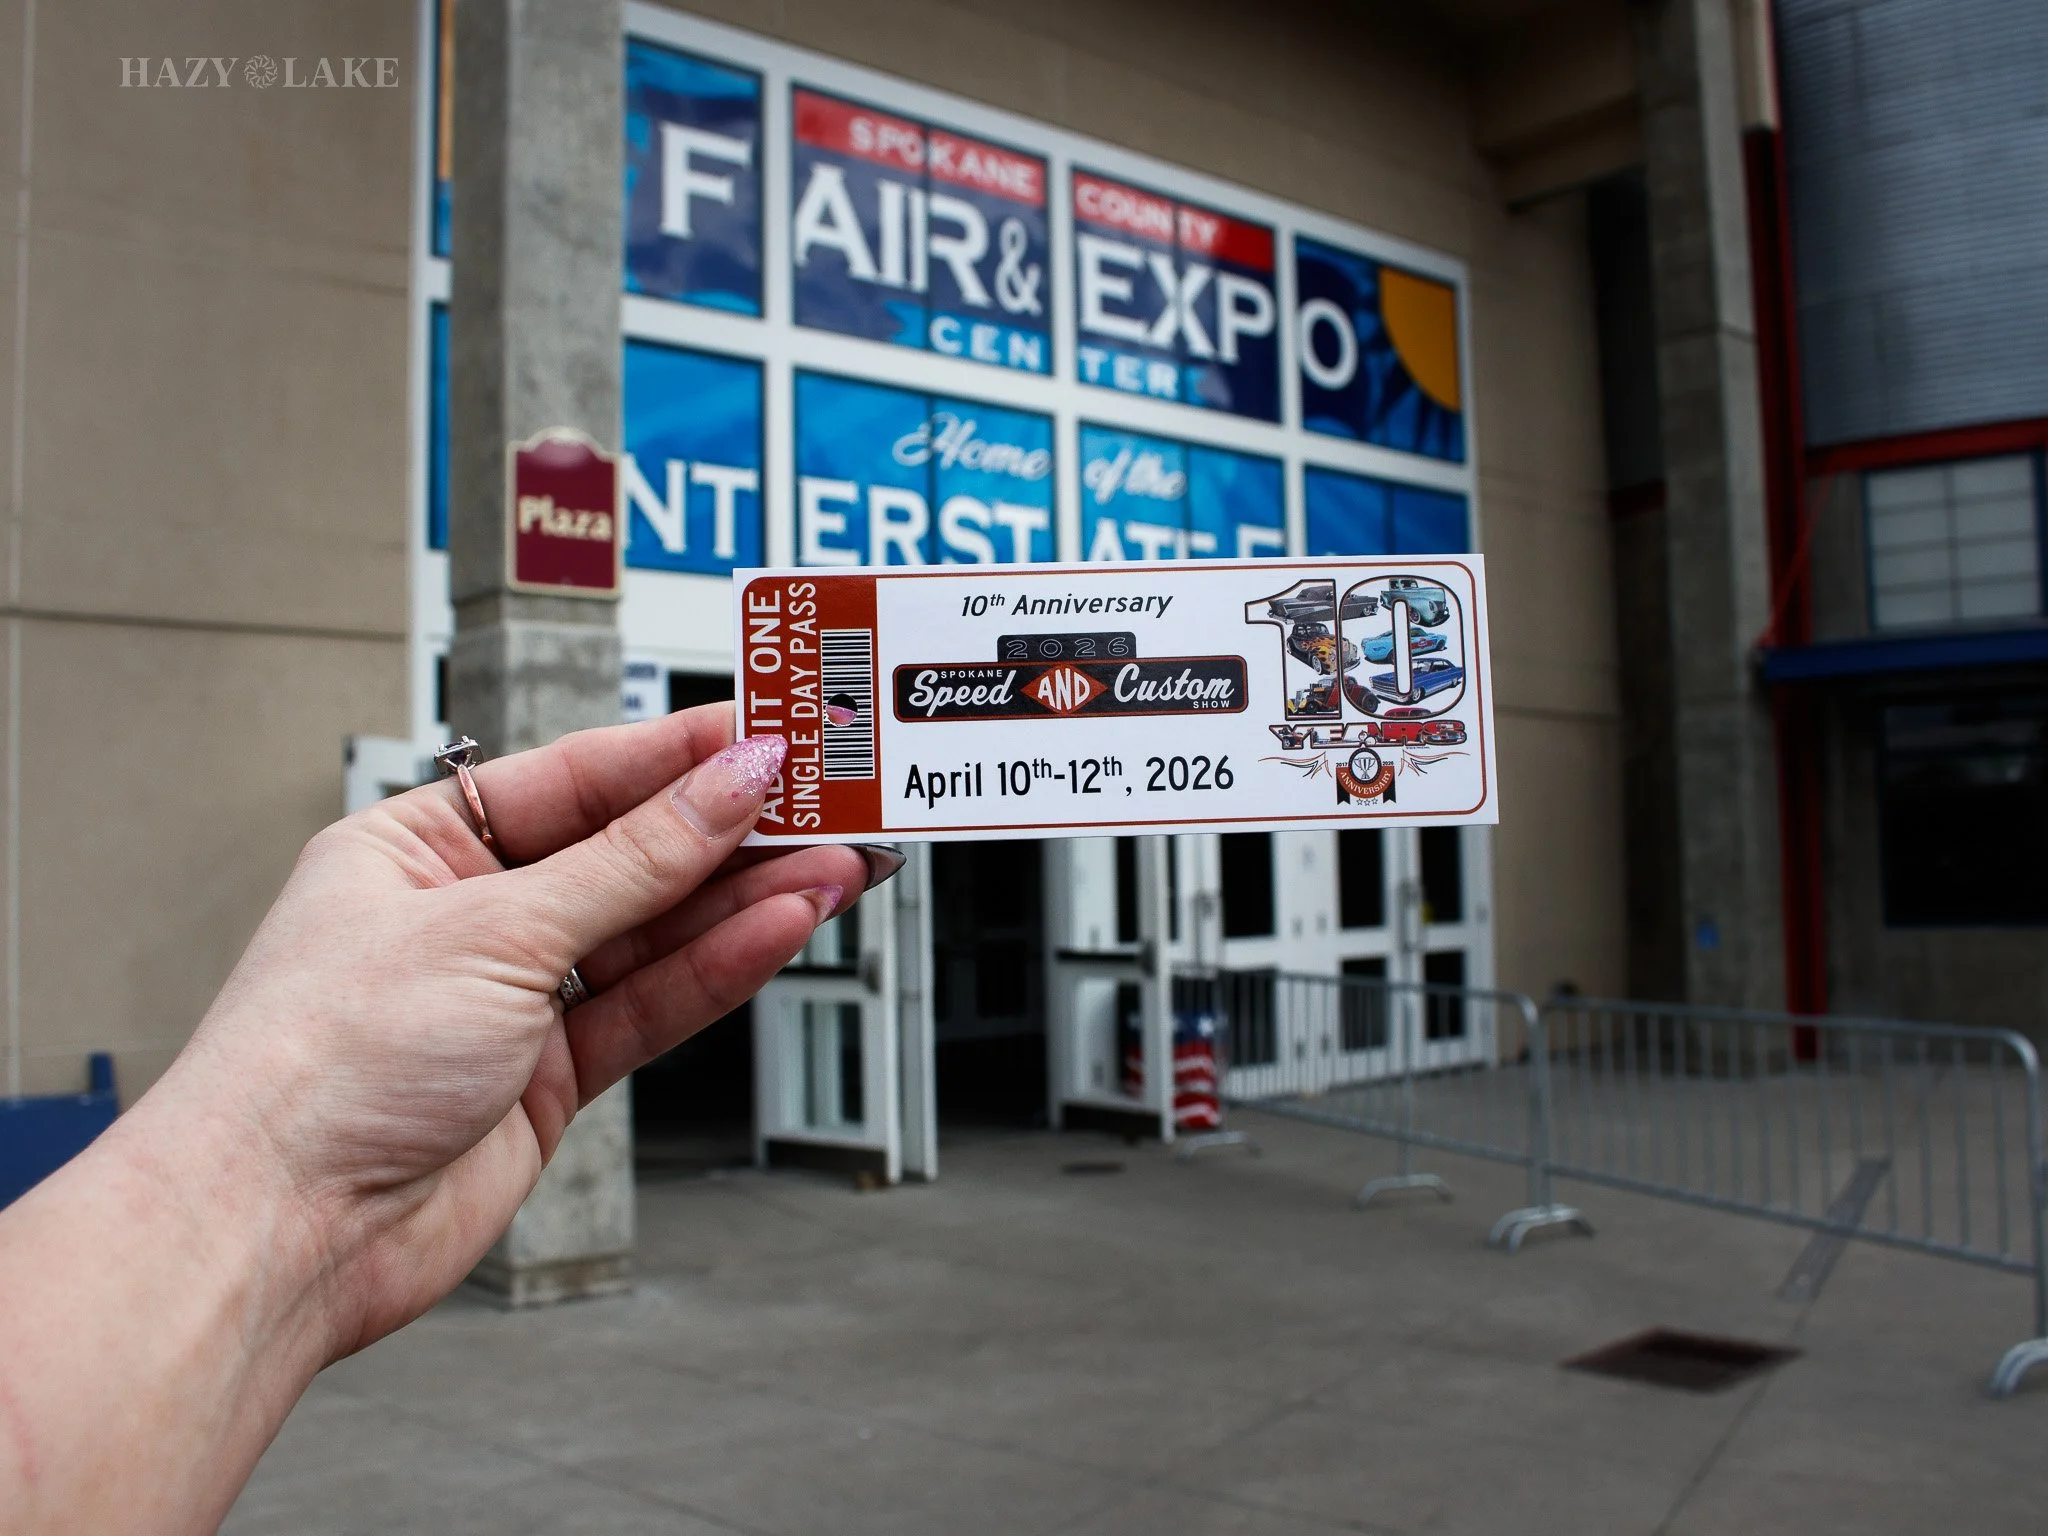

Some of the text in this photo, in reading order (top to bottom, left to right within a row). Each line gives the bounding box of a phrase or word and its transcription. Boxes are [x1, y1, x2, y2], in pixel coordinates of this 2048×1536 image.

[850, 117, 1220, 252] SPOKANE COUNTY
[659, 122, 990, 309] FAIR
[1077, 232, 1357, 390] EXPO
[930, 316, 1180, 397] CENTER
[892, 411, 1187, 505] Home of the
[519, 495, 613, 542] Plaza
[620, 452, 1217, 566] NTERSTAT
[962, 593, 1174, 618] 10th Anniversary
[940, 669, 1003, 680] SPOKANE
[1006, 636, 1130, 659] 2026
[1244, 575, 1467, 721] 10
[749, 590, 785, 824] AIT ONE
[788, 582, 822, 828] SINGLE DAY PASS
[908, 662, 1234, 717] Speed AND Custom
[1192, 700, 1230, 709] SHOW
[1268, 719, 1468, 750] YEARS
[904, 762, 982, 809] April
[1145, 755, 1234, 793] 2026
[1340, 770, 1392, 796] ANNIVERSARY
